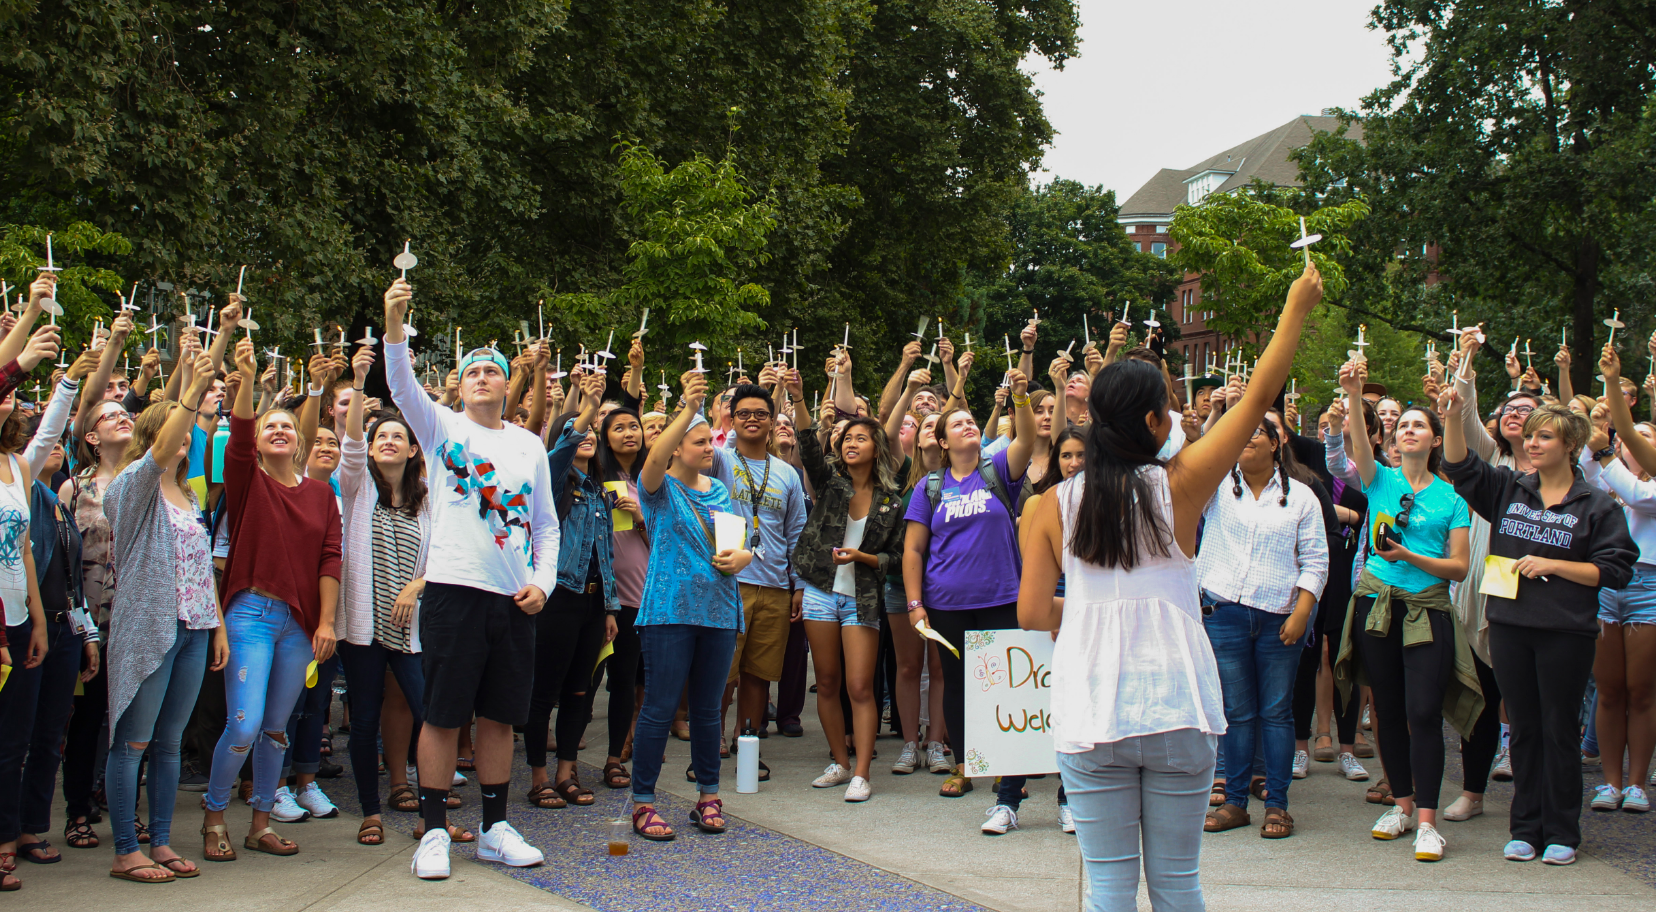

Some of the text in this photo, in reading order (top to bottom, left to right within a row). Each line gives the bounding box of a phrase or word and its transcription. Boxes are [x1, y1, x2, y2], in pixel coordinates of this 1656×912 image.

[738, 488, 783, 510] ATLETE
[944, 500, 987, 523] PILOTS
[1506, 502, 1578, 528] UNIVERSITY OF
[1499, 517, 1572, 548] PORTLAND
